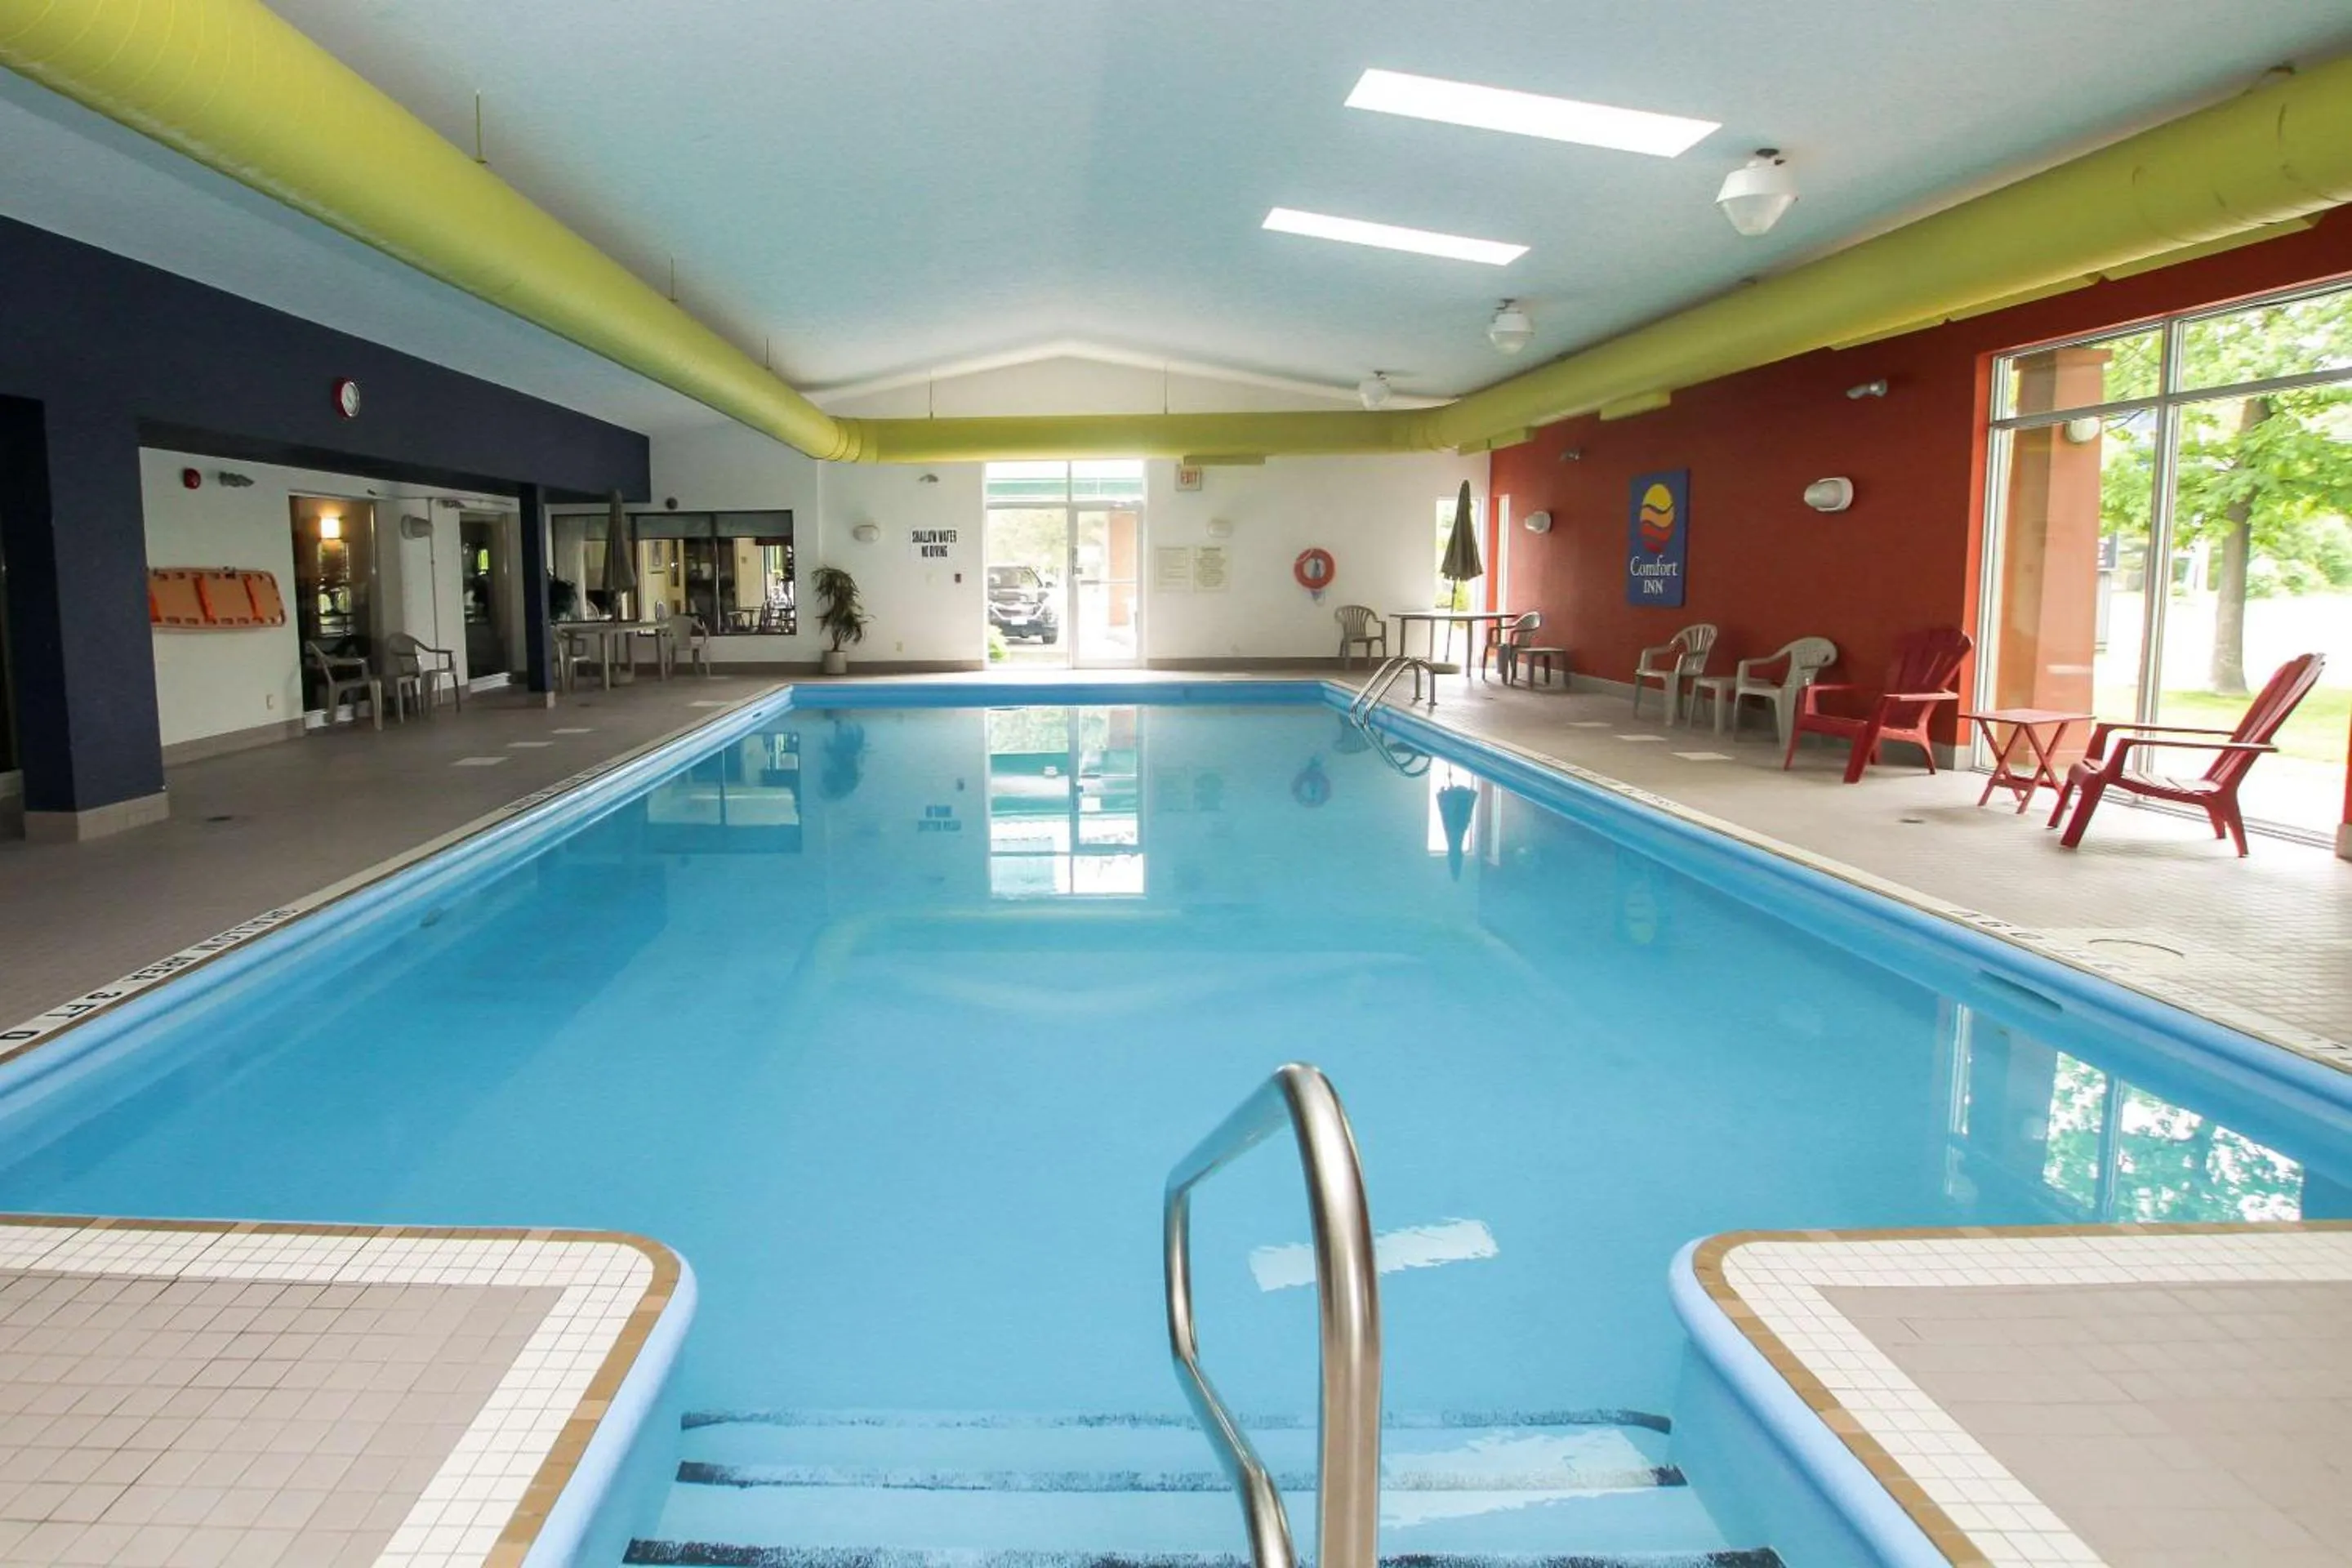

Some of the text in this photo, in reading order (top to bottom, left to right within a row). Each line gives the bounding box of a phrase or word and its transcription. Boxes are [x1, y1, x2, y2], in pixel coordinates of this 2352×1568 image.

[1180, 470, 1198, 484] EXIT
[911, 529, 957, 543] SHALLOW WATER
[921, 546, 947, 557] NO DIVING
[1630, 555, 1678, 577] Comfort
[1643, 579, 1664, 595] INN
